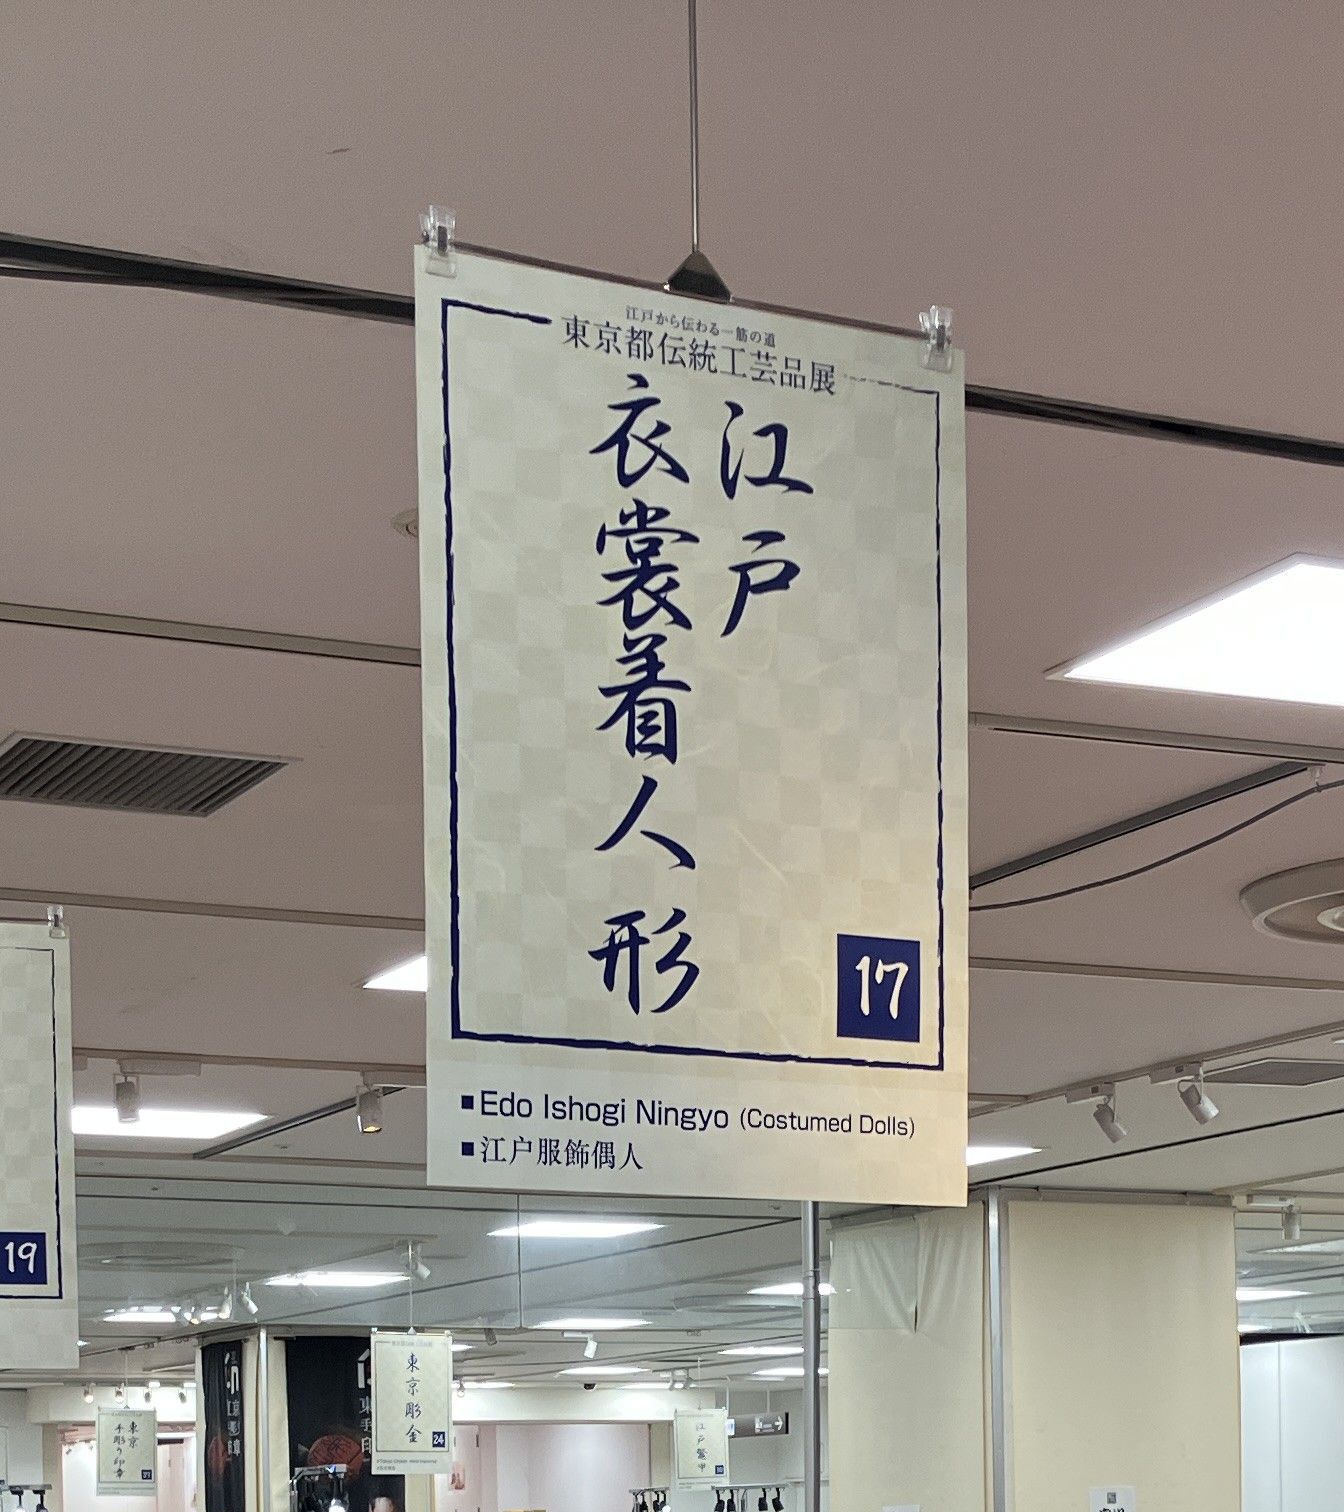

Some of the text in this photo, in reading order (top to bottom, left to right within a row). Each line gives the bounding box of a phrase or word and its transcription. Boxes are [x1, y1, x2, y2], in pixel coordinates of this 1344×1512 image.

[562, 314, 836, 396] 東京都伝統工芸品展
[625, 305, 776, 348] 江戸から伝わる一筋の道
[720, 400, 814, 638] 江戸
[588, 373, 701, 1015] 衣裳着人形
[854, 955, 910, 1020] 17
[480, 1090, 916, 1138] Edo Ishogi Ningyo (Costumed Dolls)
[4, 1241, 38, 1274] 19
[405, 1353, 422, 1443] 東京彫金
[433, 1433, 445, 1446] 24
